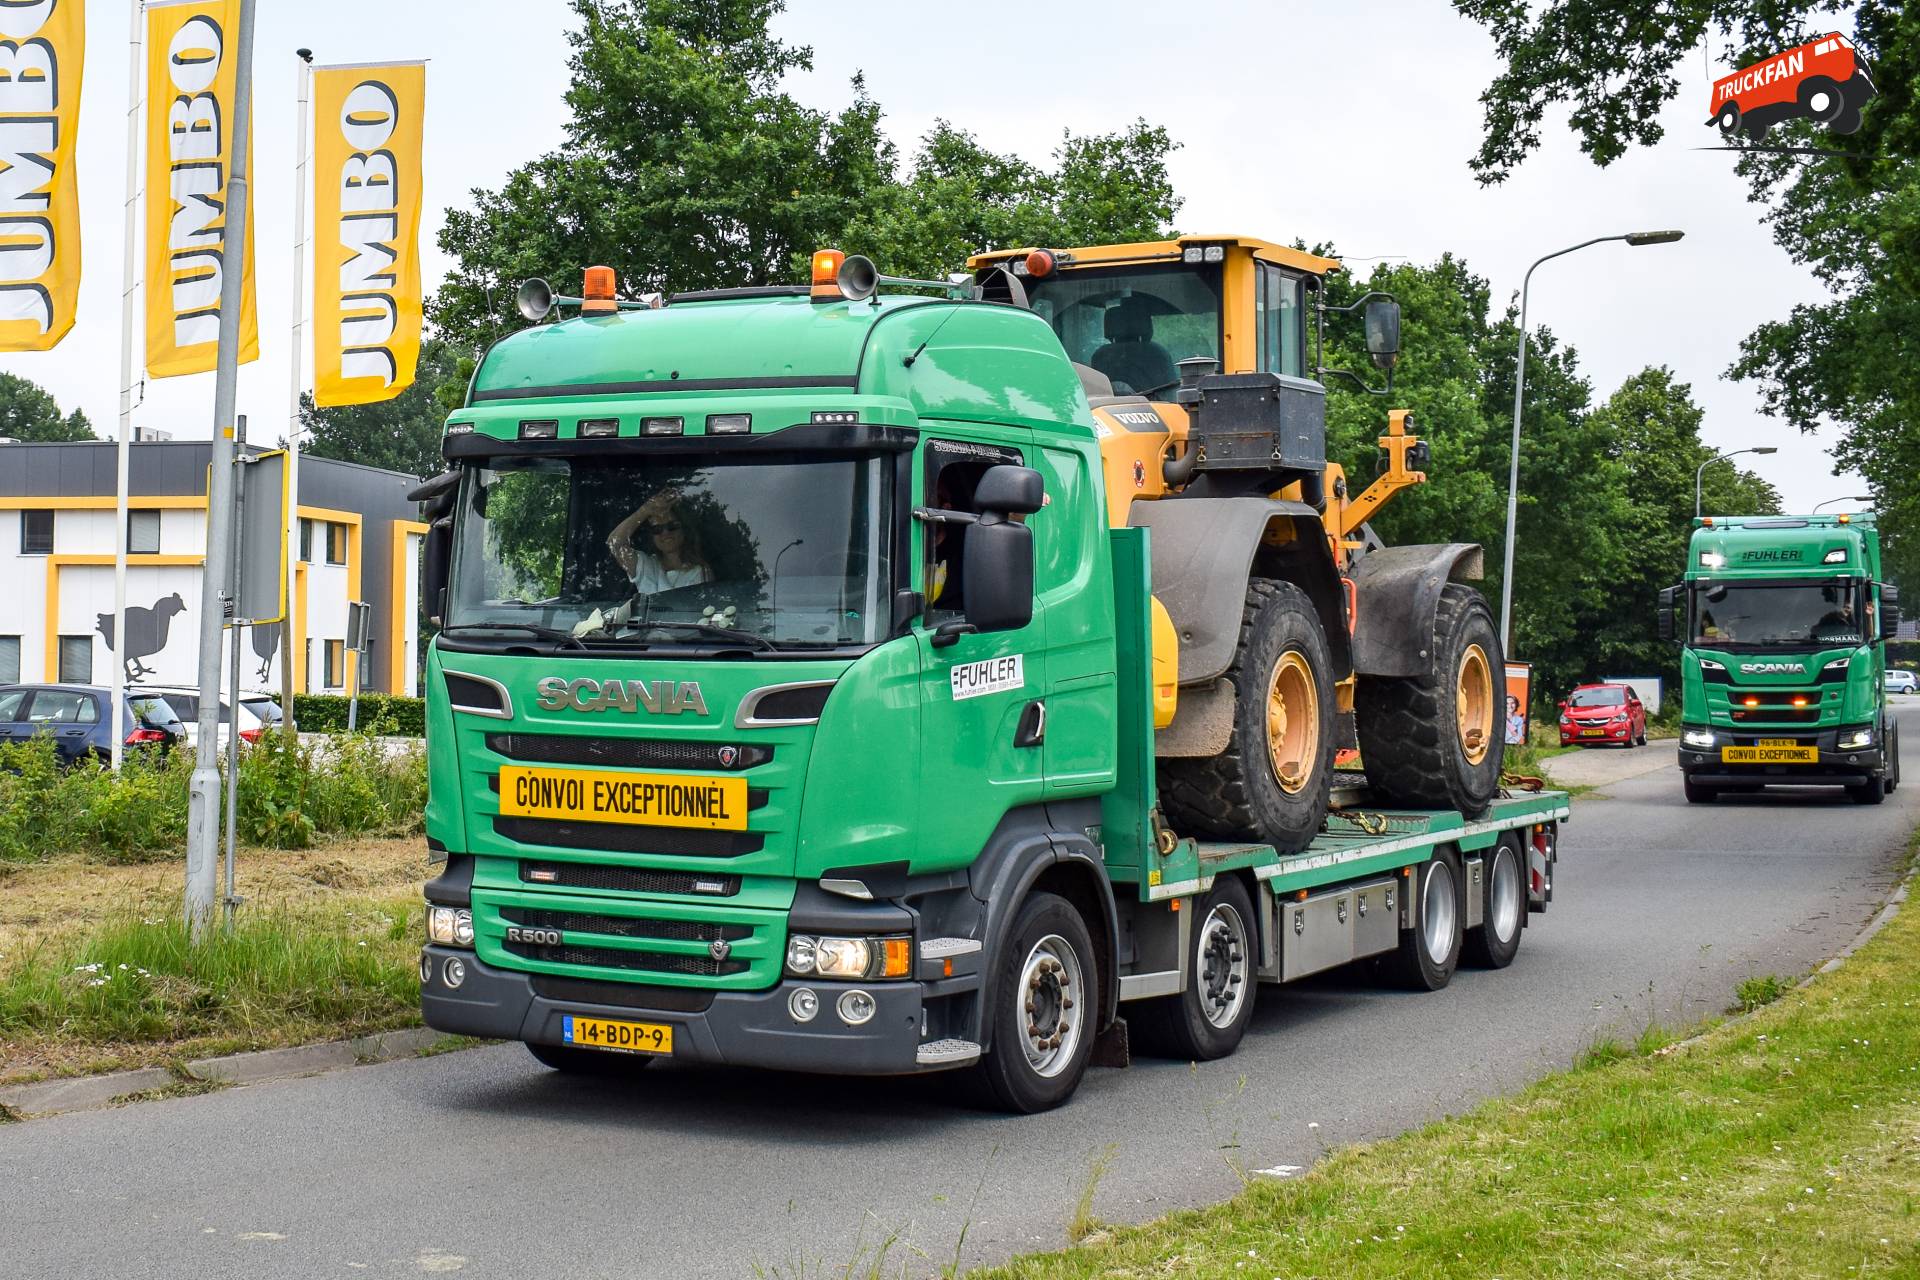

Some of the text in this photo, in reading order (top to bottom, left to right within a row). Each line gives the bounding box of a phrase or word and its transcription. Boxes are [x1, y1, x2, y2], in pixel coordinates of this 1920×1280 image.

[167, 14, 224, 348] JUMBO
[340, 79, 399, 389] JUMBO
[1112, 412, 1161, 424] VOLVO
[1747, 550, 1799, 560] FUHLER
[959, 657, 1016, 689] FUHLER
[1740, 663, 1807, 674] SCANIA
[536, 676, 709, 715] SCANIA
[1728, 749, 1811, 760] CONVOI EXCEPTIONNEL
[516, 776, 730, 820] CONVOI EXCEPTIONNEL
[580, 1022, 663, 1048] 14-BDP-9
